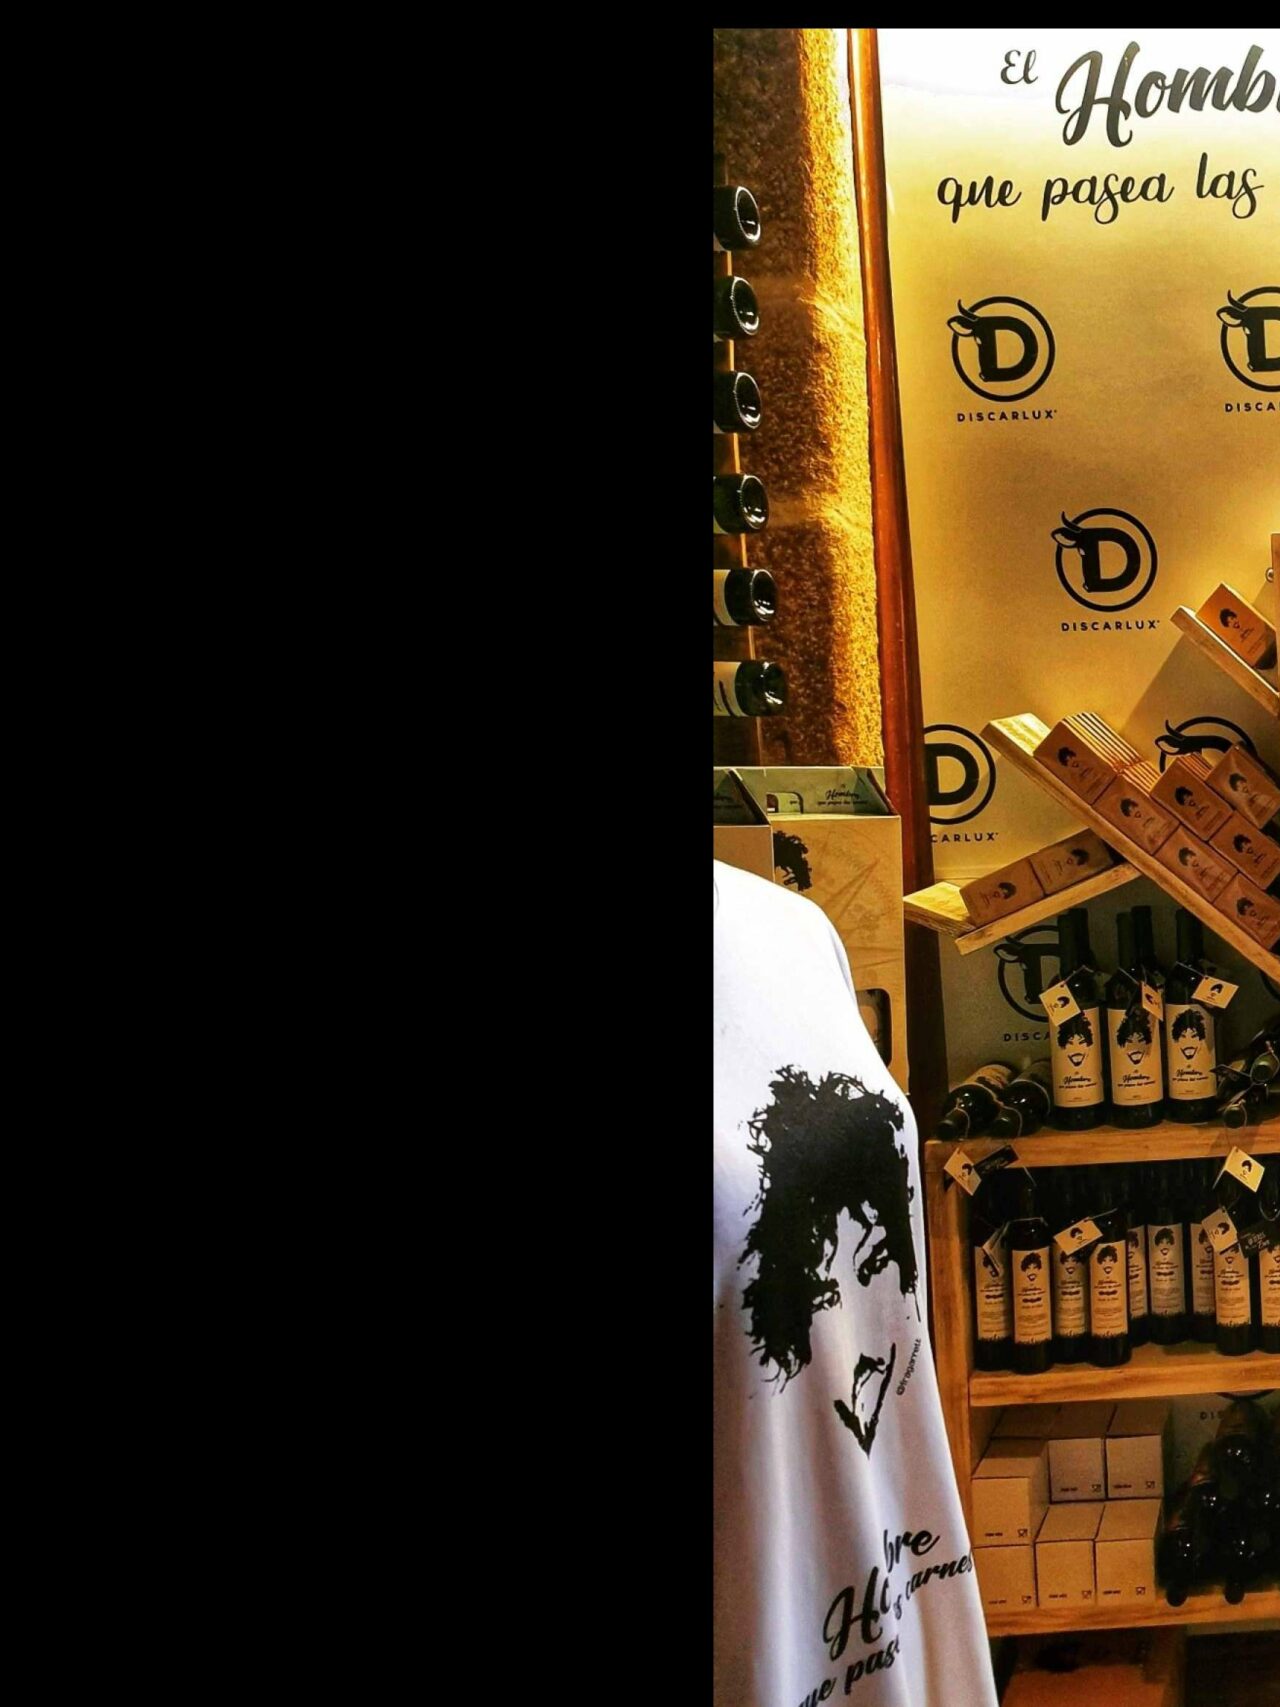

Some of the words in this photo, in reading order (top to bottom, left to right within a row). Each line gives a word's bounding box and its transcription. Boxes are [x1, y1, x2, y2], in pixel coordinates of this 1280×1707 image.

[1000, 49, 1039, 85] El
[937, 174, 1022, 224] que
[1041, 171, 1174, 224] pasea
[1196, 152, 1264, 219] las
[957, 409, 1057, 422] DISCARLUX
[1061, 620, 1160, 632] DISCARLUX
[930, 832, 999, 843] CARLUX
[1003, 1031, 1050, 1042] DISCA
